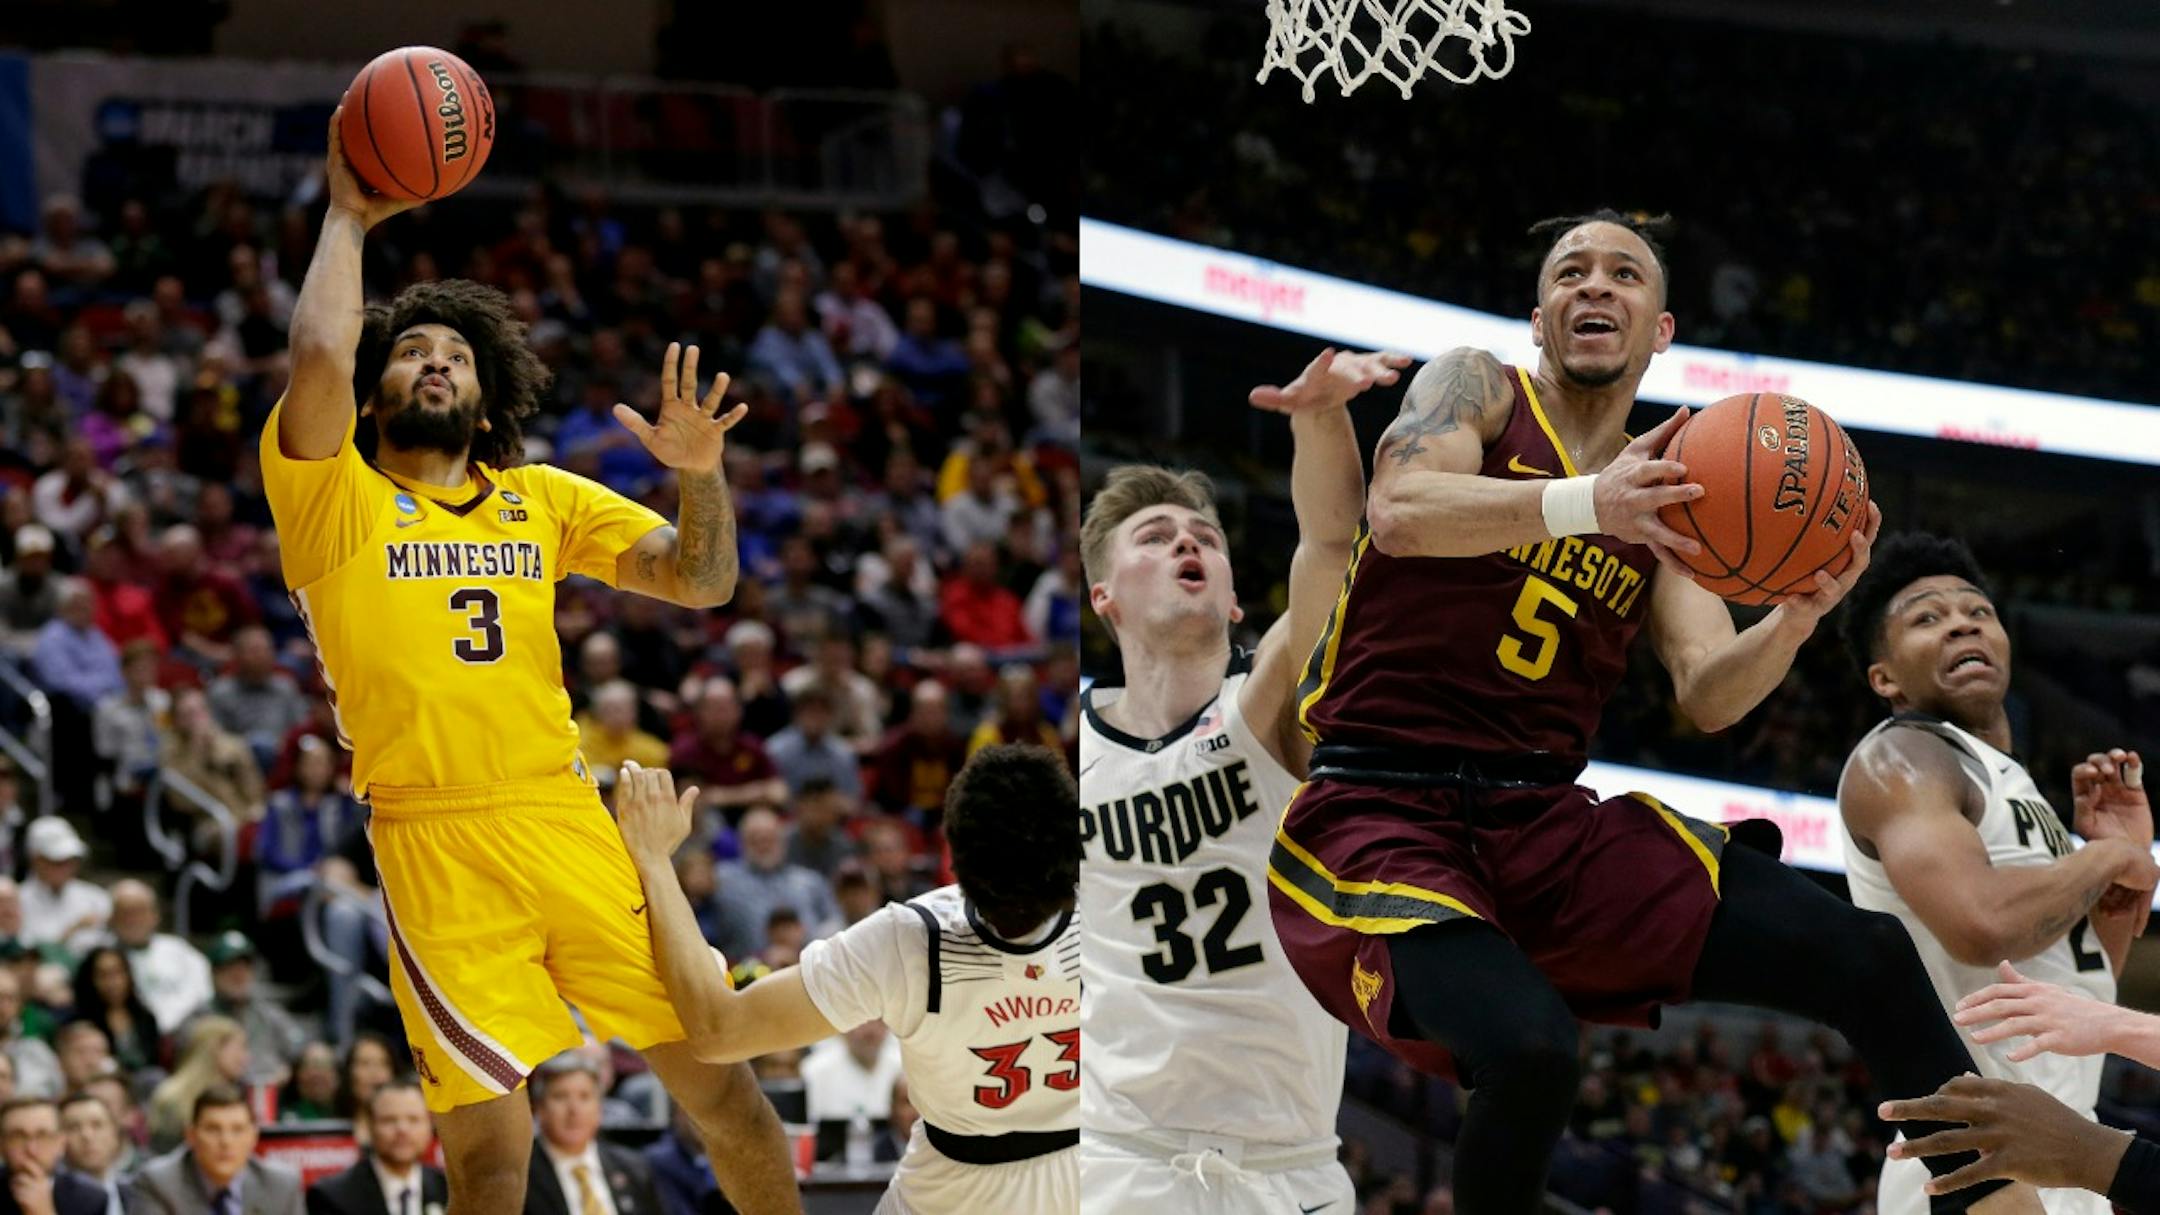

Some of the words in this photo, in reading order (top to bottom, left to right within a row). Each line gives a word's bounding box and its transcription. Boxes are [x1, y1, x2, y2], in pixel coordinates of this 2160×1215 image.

[429, 62, 467, 164] Wilson
[385, 541, 544, 580] MINNESOTA
[1500, 534, 1647, 619] NNESOTA
[449, 587, 505, 665] 3
[1496, 574, 1579, 681] 5
[1080, 761, 1259, 866] PURDUE
[1130, 867, 1265, 984] 32
[985, 996, 1080, 1028] NWOR
[968, 1027, 1080, 1109] 33
